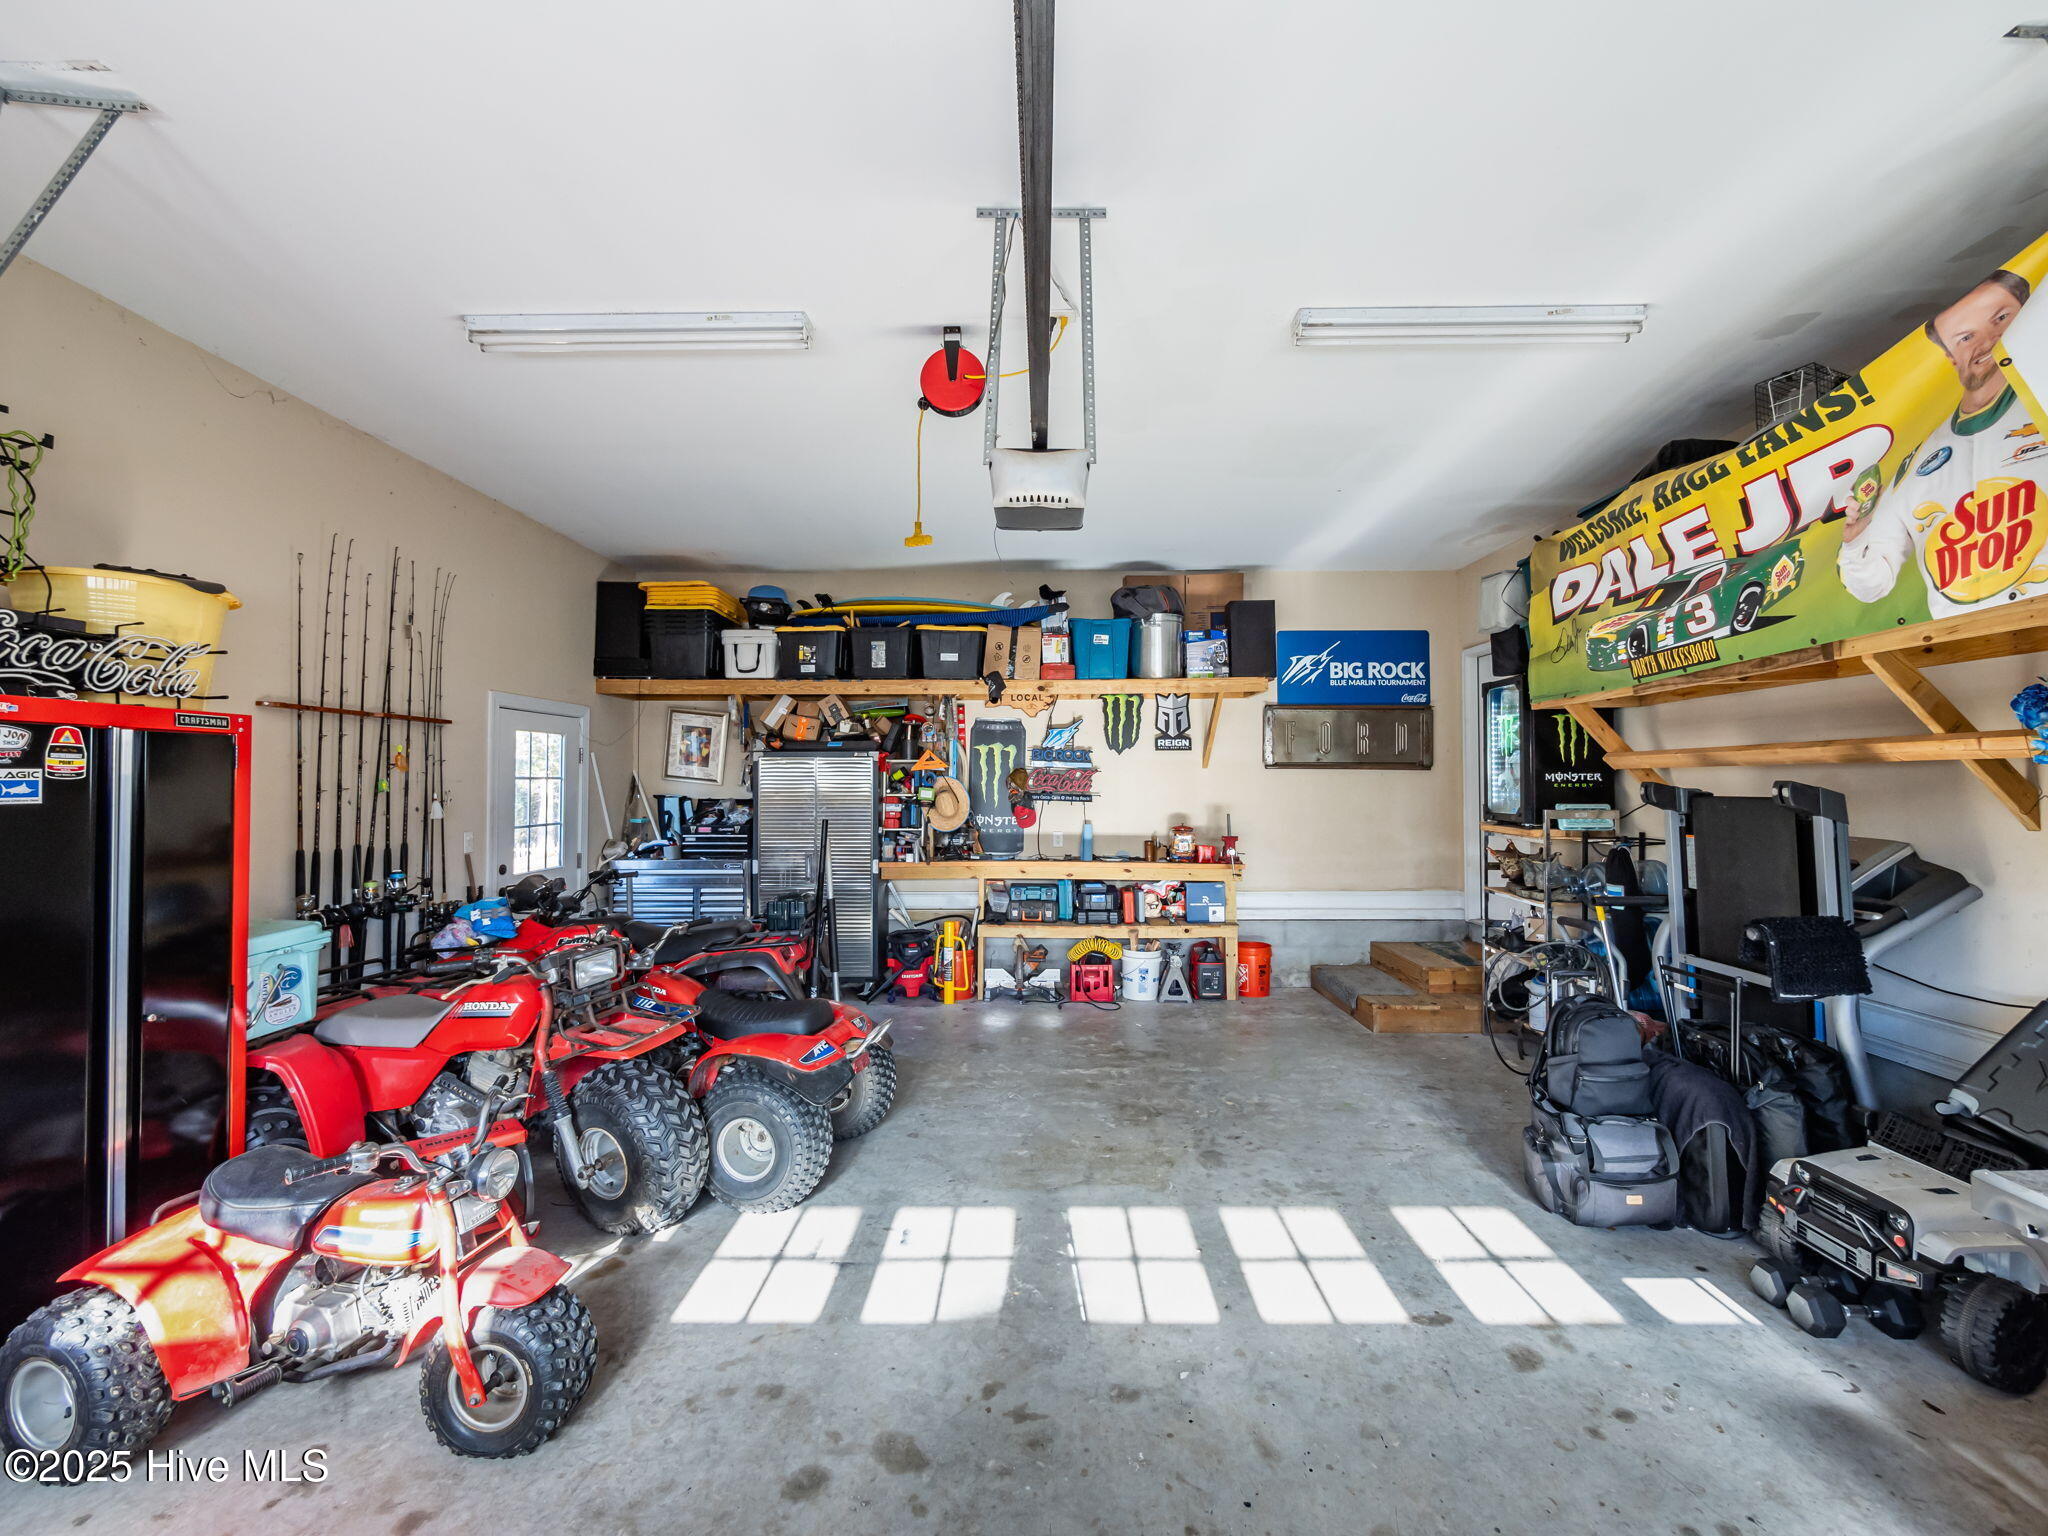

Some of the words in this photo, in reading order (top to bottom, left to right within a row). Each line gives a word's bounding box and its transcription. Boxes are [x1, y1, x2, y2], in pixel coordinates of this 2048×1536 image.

[1939, 479, 2036, 546] Sun
[1551, 502, 1726, 622] DALE
[1735, 423, 1895, 556] JR
[1559, 494, 1649, 562] WELCOME,
[1683, 592, 1717, 636] 3
[1630, 652, 1658, 678] NORTH
[1656, 639, 1718, 673] WILKESBORO
[1329, 661, 1363, 679] BIG
[1368, 661, 1426, 679] ROCK
[1377, 679, 1427, 687] TOURNAMENT
[1010, 693, 1044, 702] LOCAL
[179, 715, 228, 727] CRAFTSMAN
[1157, 738, 1190, 747] REIGN
[1285, 720, 1409, 756] FORD
[1055, 749, 1092, 761] ROCK
[0, 771, 40, 779] AGIC
[1026, 768, 1099, 792] Coca-Cola
[1544, 771, 1603, 782] MONSTER
[974, 813, 1018, 826] ONSTE
[462, 1001, 511, 1011] HONDA
[636, 998, 657, 1009] 110
[813, 1039, 829, 1057] ATC
